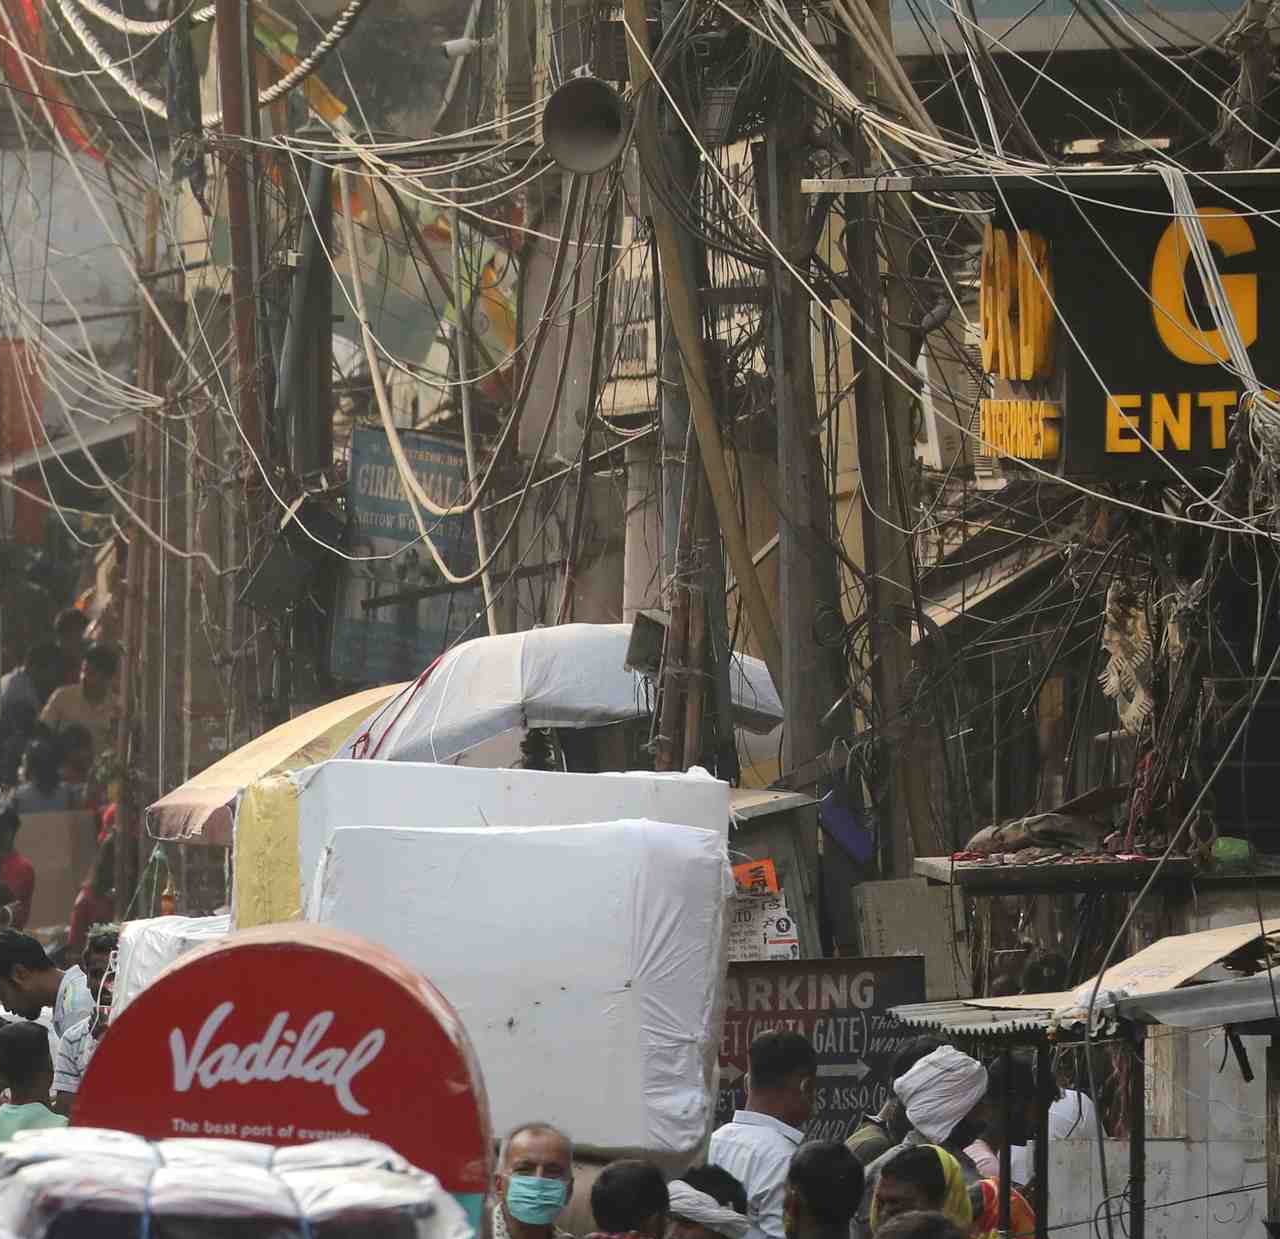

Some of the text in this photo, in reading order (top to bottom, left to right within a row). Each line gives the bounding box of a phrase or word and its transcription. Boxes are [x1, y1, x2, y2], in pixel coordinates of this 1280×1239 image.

[1105, 389, 1280, 453] ENT
[727, 971, 875, 1012] ARKING
[721, 1019, 741, 1056] ET
[169, 1001, 385, 1116] Vadilal
[171, 1118, 197, 1133] The
[203, 1120, 237, 1135] best
[241, 1124, 272, 1141] part
[277, 1125, 294, 1138] of
